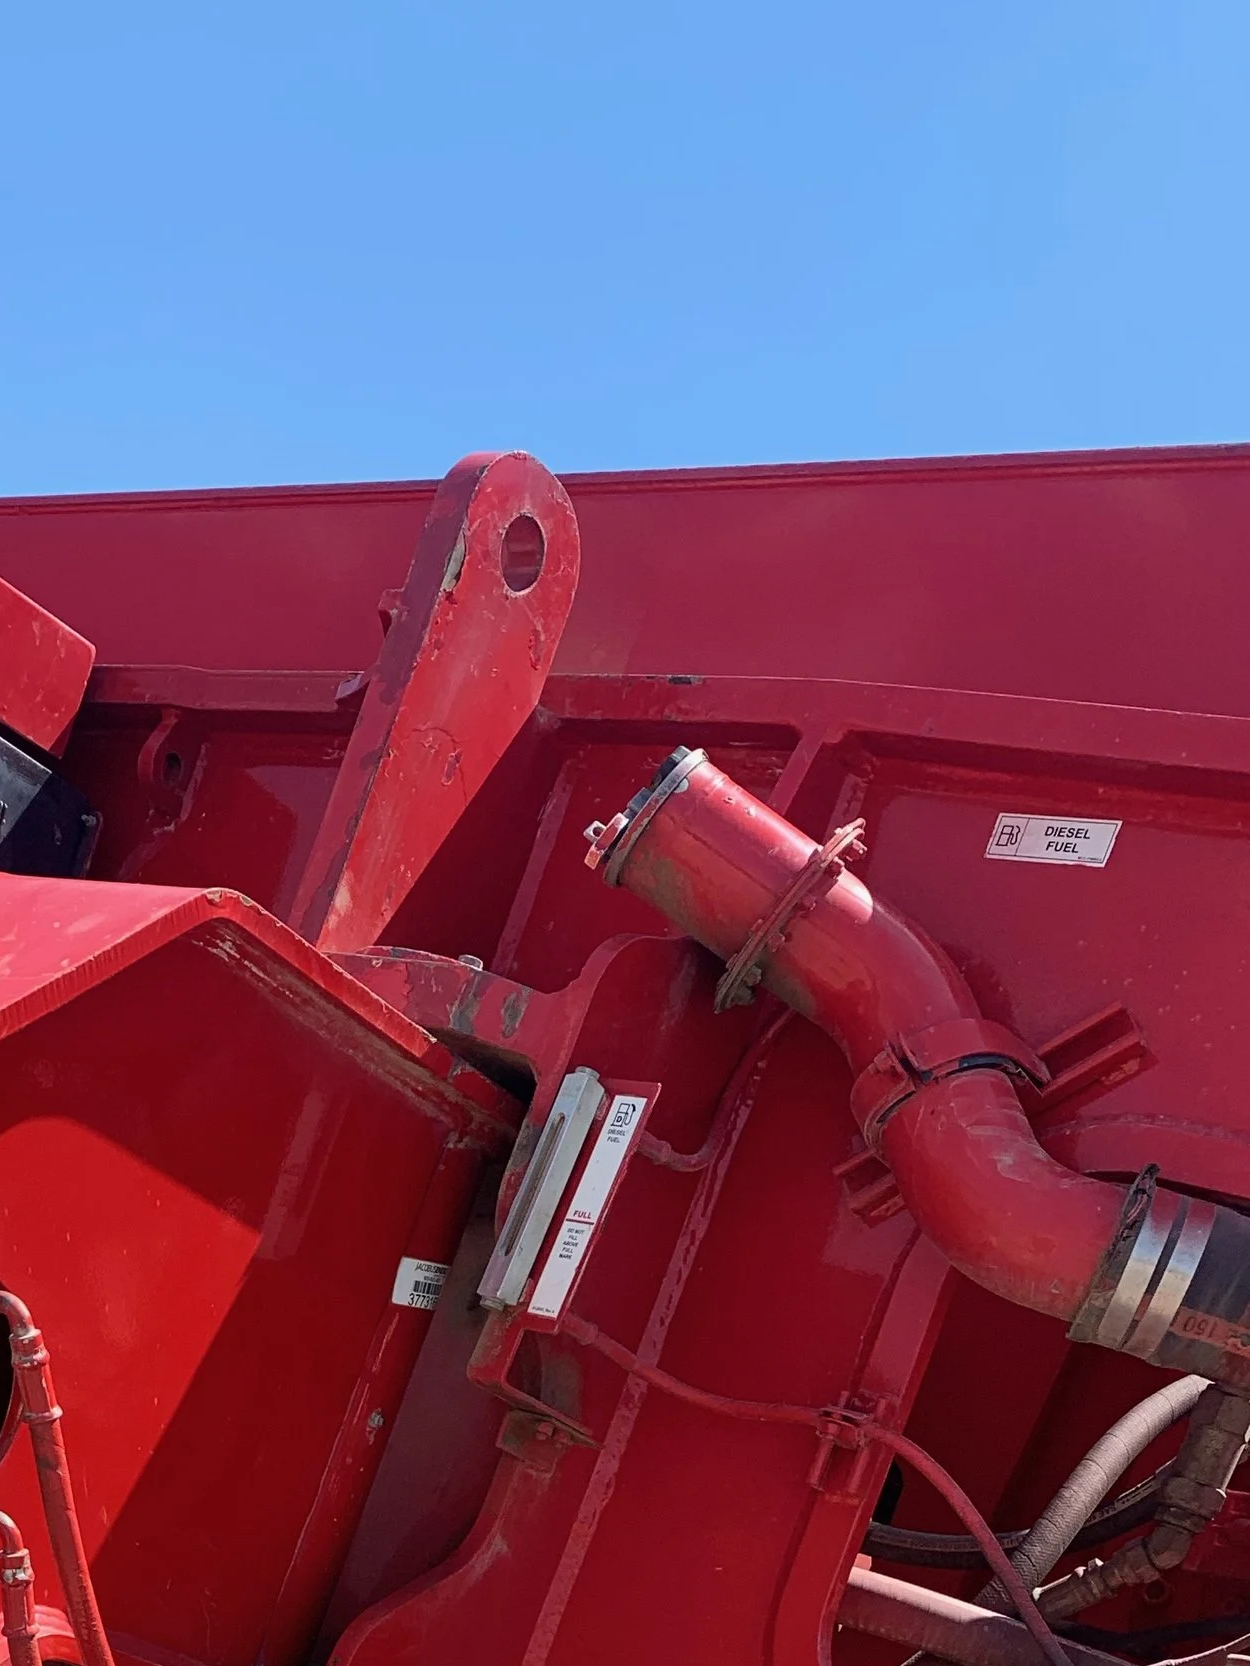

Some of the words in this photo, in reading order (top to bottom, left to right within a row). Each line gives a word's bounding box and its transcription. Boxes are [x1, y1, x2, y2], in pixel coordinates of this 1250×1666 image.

[1045, 826, 1090, 839] DIESEL
[1045, 841, 1079, 853] FUEL
[573, 1210, 592, 1220] FULL
